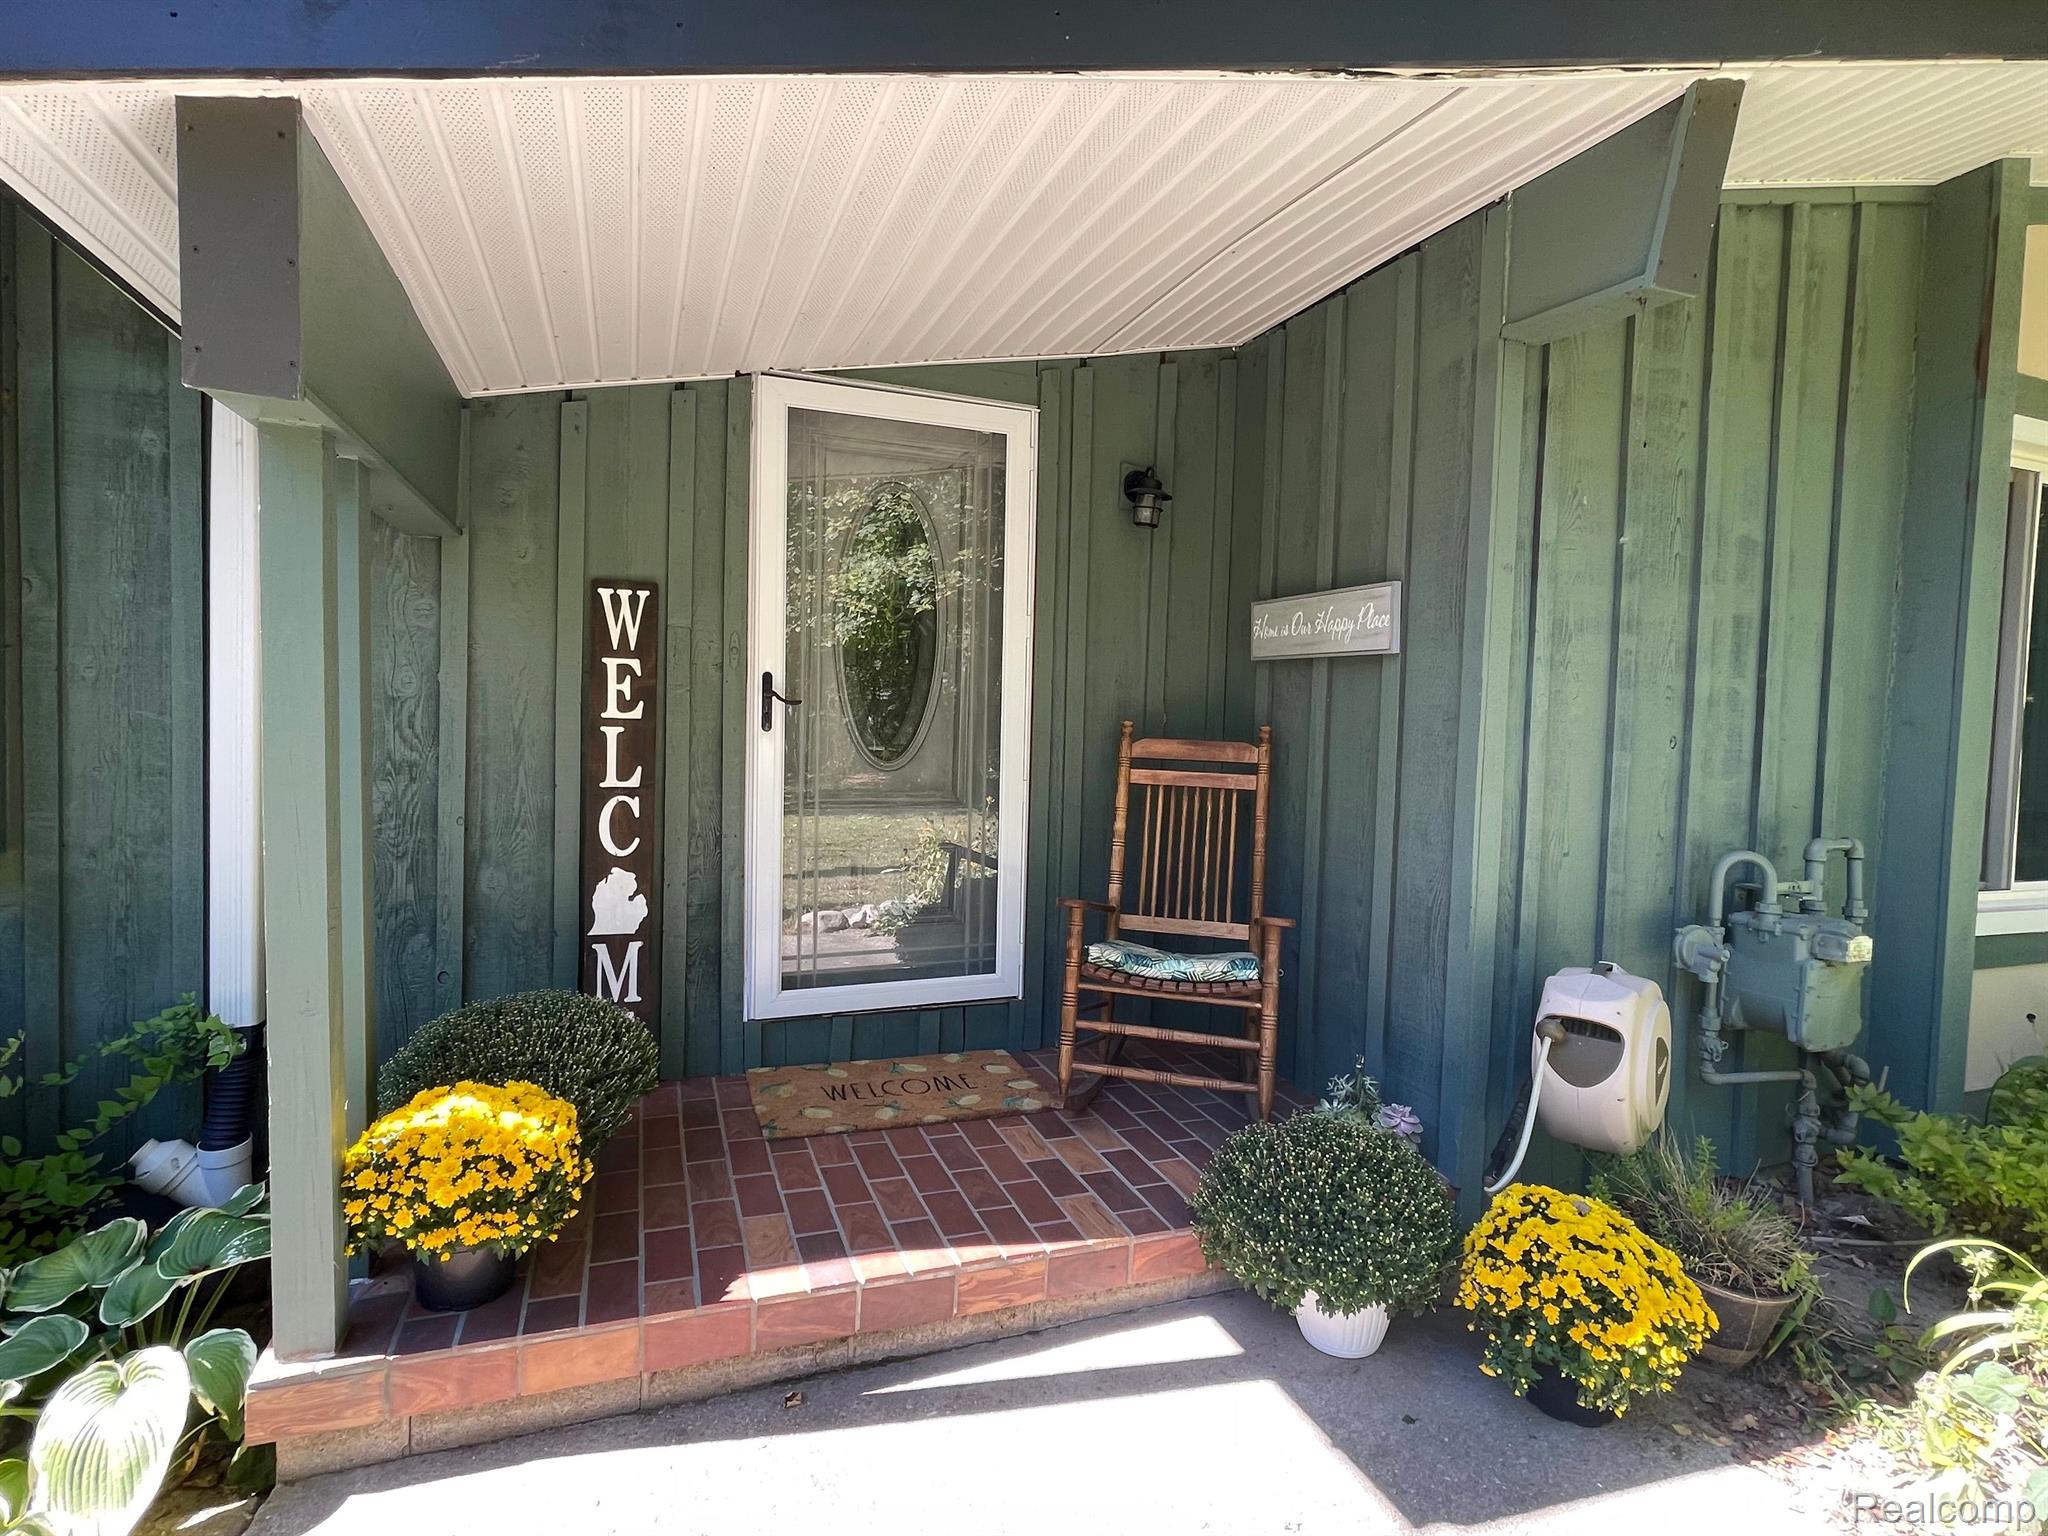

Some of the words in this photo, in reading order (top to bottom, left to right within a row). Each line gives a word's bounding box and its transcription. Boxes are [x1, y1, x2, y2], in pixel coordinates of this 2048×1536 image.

[1253, 614, 1279, 640] Home
[1280, 624, 1289, 637] is
[1291, 611, 1311, 636] Our
[1314, 606, 1354, 644] Happy
[1357, 602, 1391, 630] Place
[587, 587, 651, 1019] WELCM
[820, 1073, 978, 1101] WELCOME
